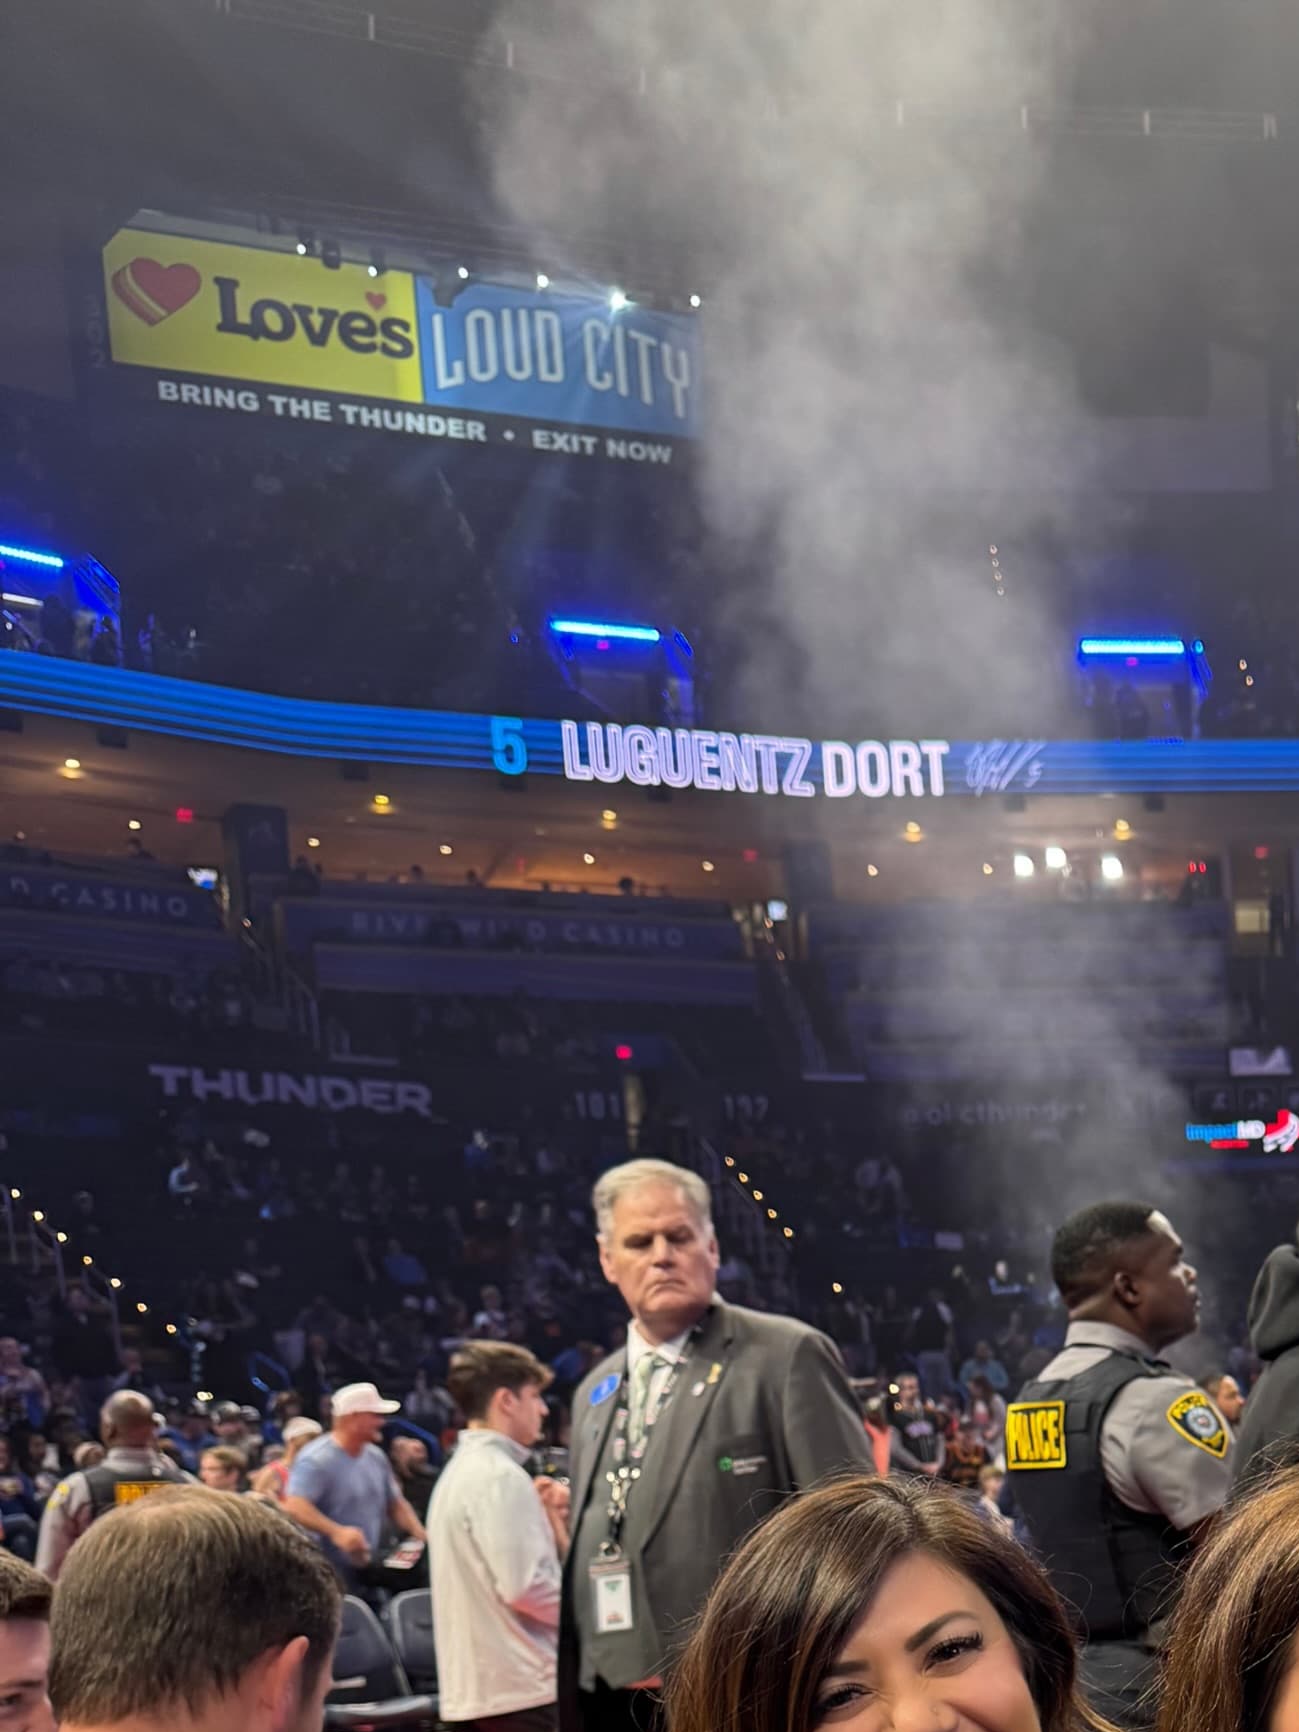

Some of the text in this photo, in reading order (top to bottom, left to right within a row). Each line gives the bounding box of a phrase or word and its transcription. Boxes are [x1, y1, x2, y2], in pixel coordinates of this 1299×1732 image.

[432, 307, 690, 420] LOUD CITY
[157, 380, 673, 464] BRING THE THUNDER EXIT NOW
[490, 716, 528, 776] 5
[560, 718, 816, 798] LUGUENTZ
[821, 740, 951, 799] DORT
[51, 881, 188, 918] CASINO
[148, 1063, 433, 1119] THUNDER
[1009, 1410, 1060, 1461] POLICE
